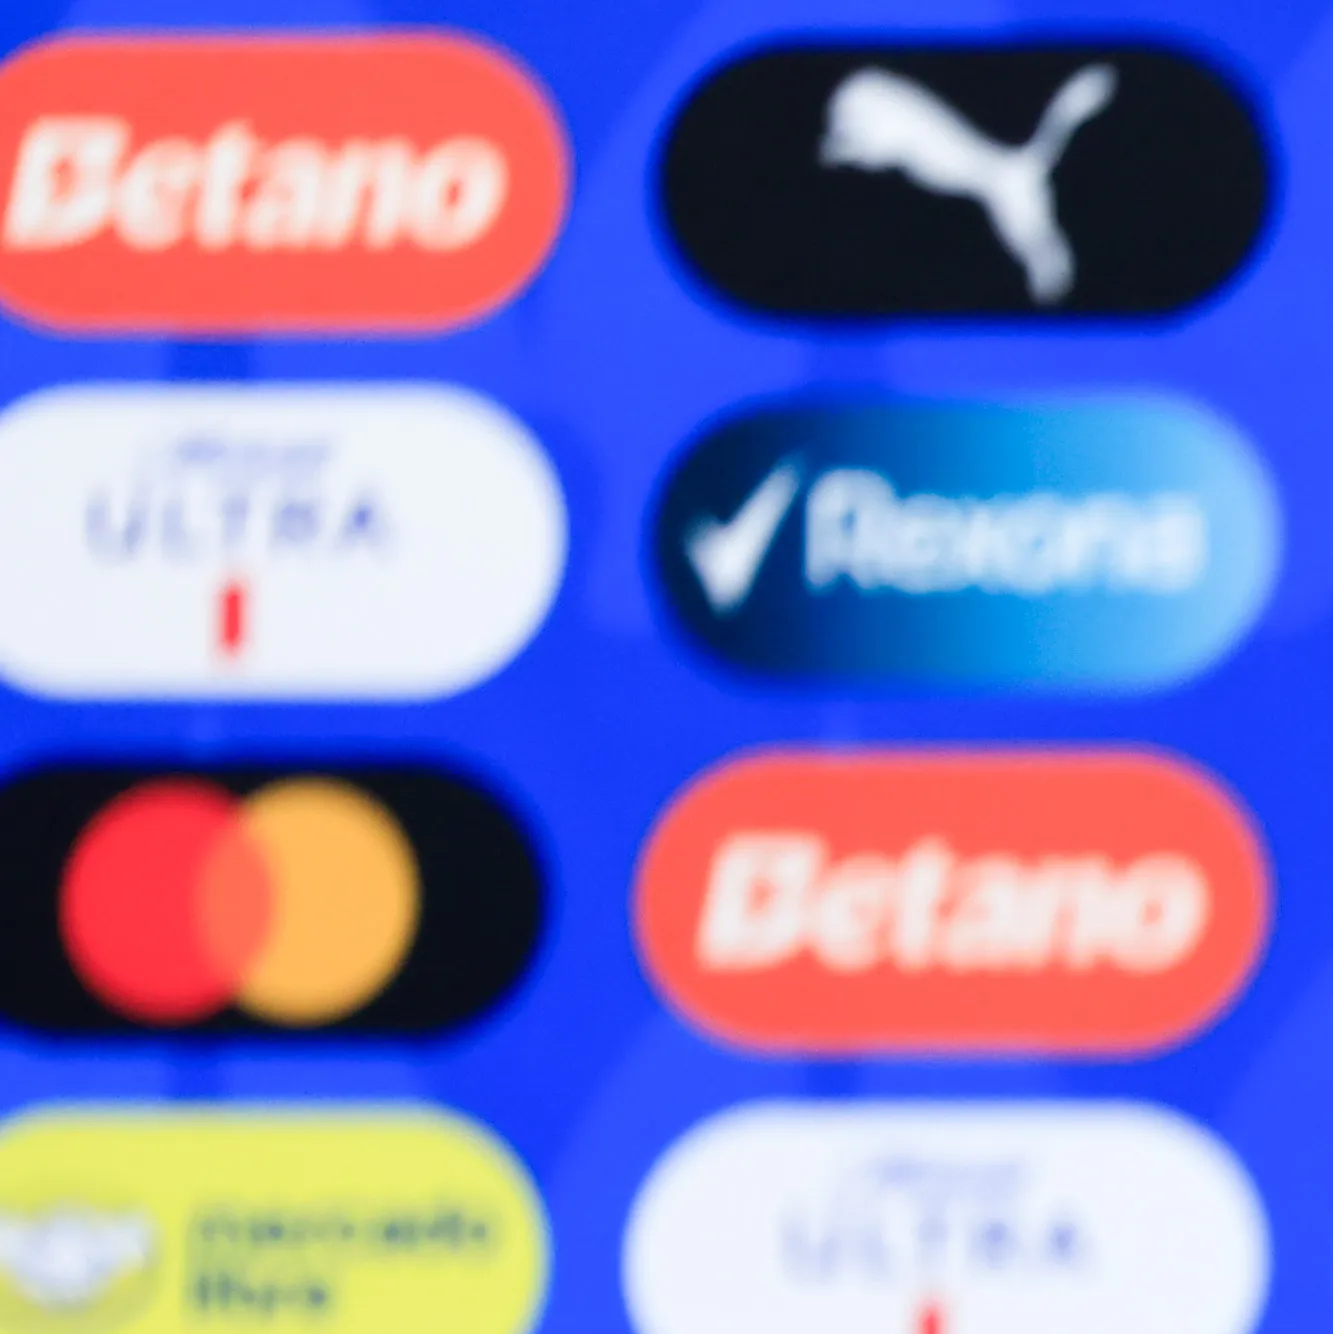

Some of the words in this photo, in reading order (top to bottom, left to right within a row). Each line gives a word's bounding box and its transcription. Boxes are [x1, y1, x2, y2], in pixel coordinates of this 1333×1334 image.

[3, 113, 512, 252] Betano
[82, 480, 392, 572] ULTRA
[805, 466, 1207, 595] Rexona
[696, 830, 1214, 976] Betano
